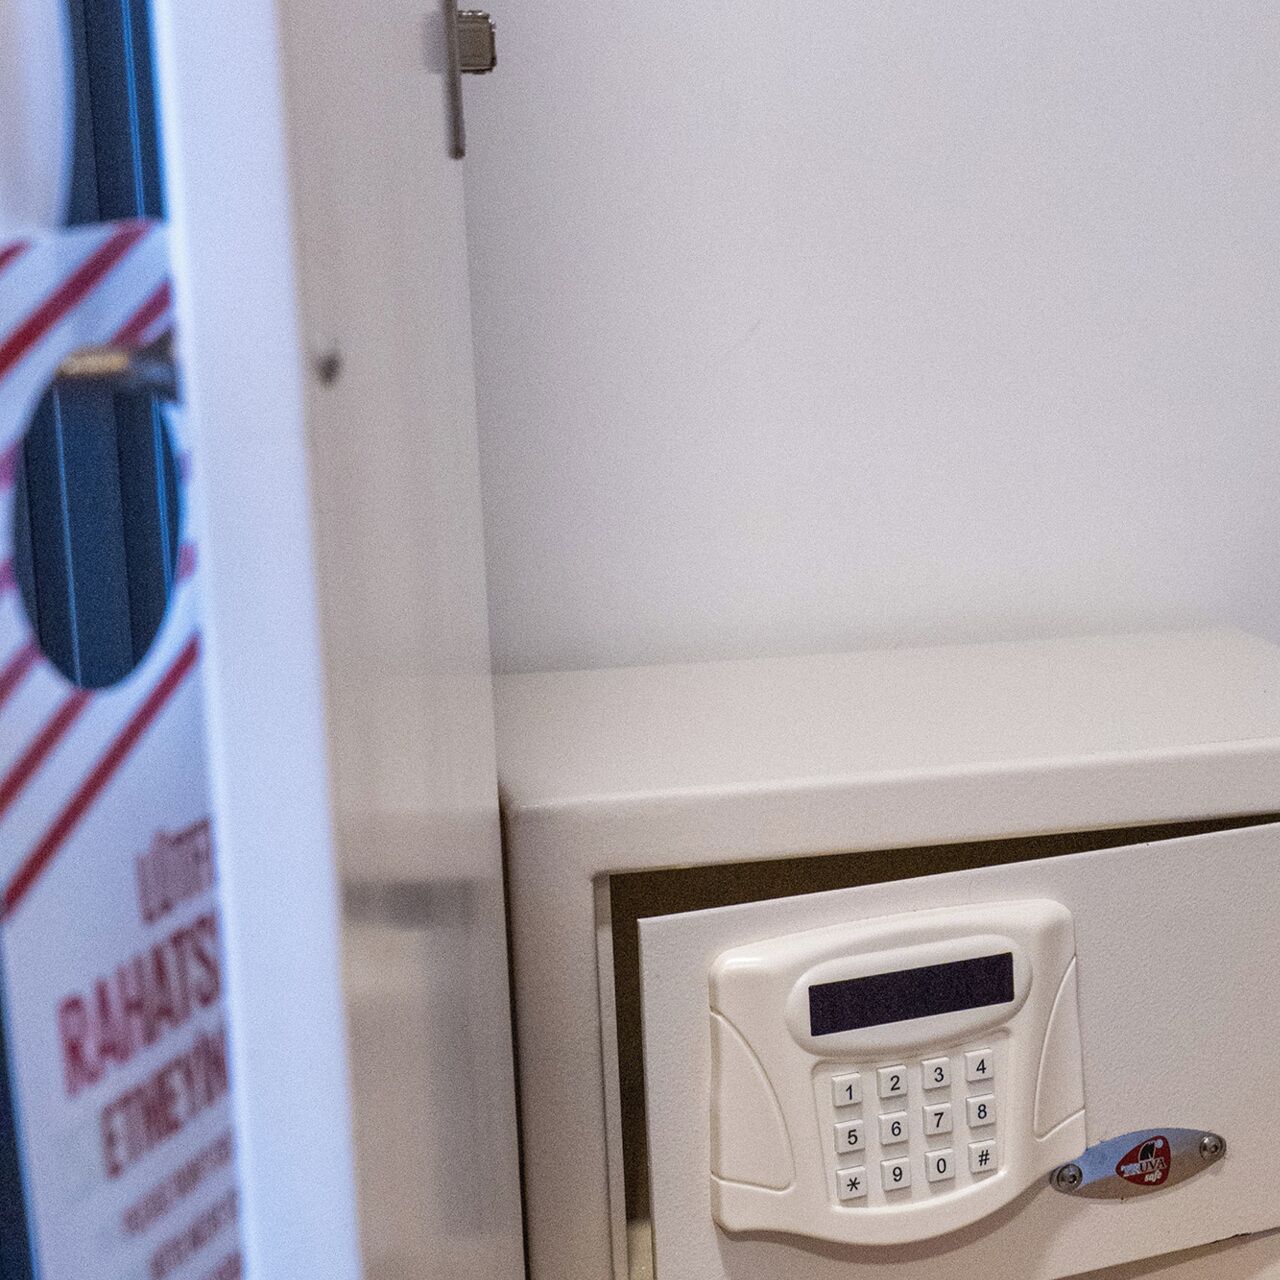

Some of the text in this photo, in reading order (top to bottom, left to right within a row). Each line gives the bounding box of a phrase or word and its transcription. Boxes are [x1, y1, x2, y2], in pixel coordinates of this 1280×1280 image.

[845, 1059, 987, 1101] 1 2 3 4
[847, 1104, 987, 1145] 5 6 7 8
[892, 1166, 903, 1182] 9
[936, 1158, 947, 1174] 0
